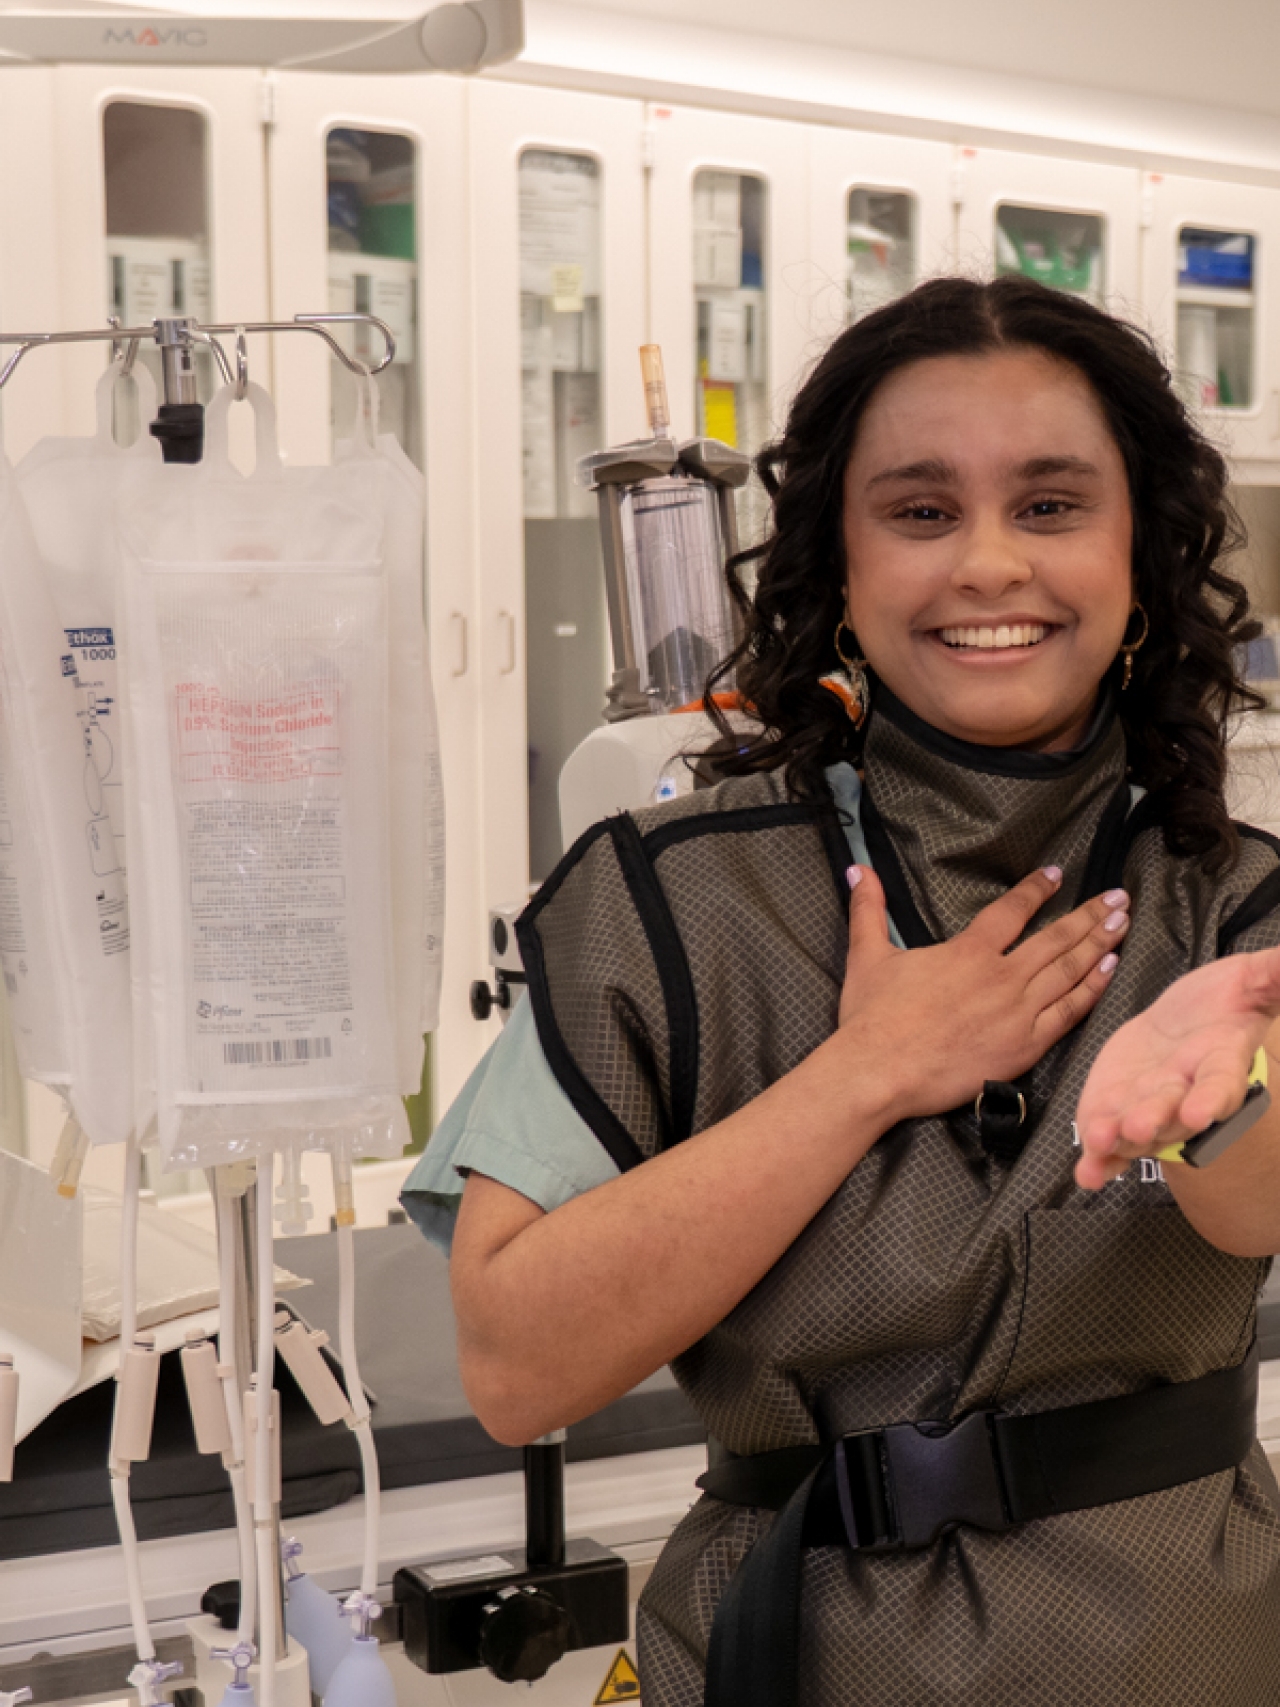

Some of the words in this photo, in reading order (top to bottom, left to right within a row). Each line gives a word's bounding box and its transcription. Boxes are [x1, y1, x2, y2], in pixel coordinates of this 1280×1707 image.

[82, 648, 116, 660] 1000
[311, 695, 324, 709] in
[220, 717, 271, 736] Sodium
[275, 711, 333, 733] Chloride
